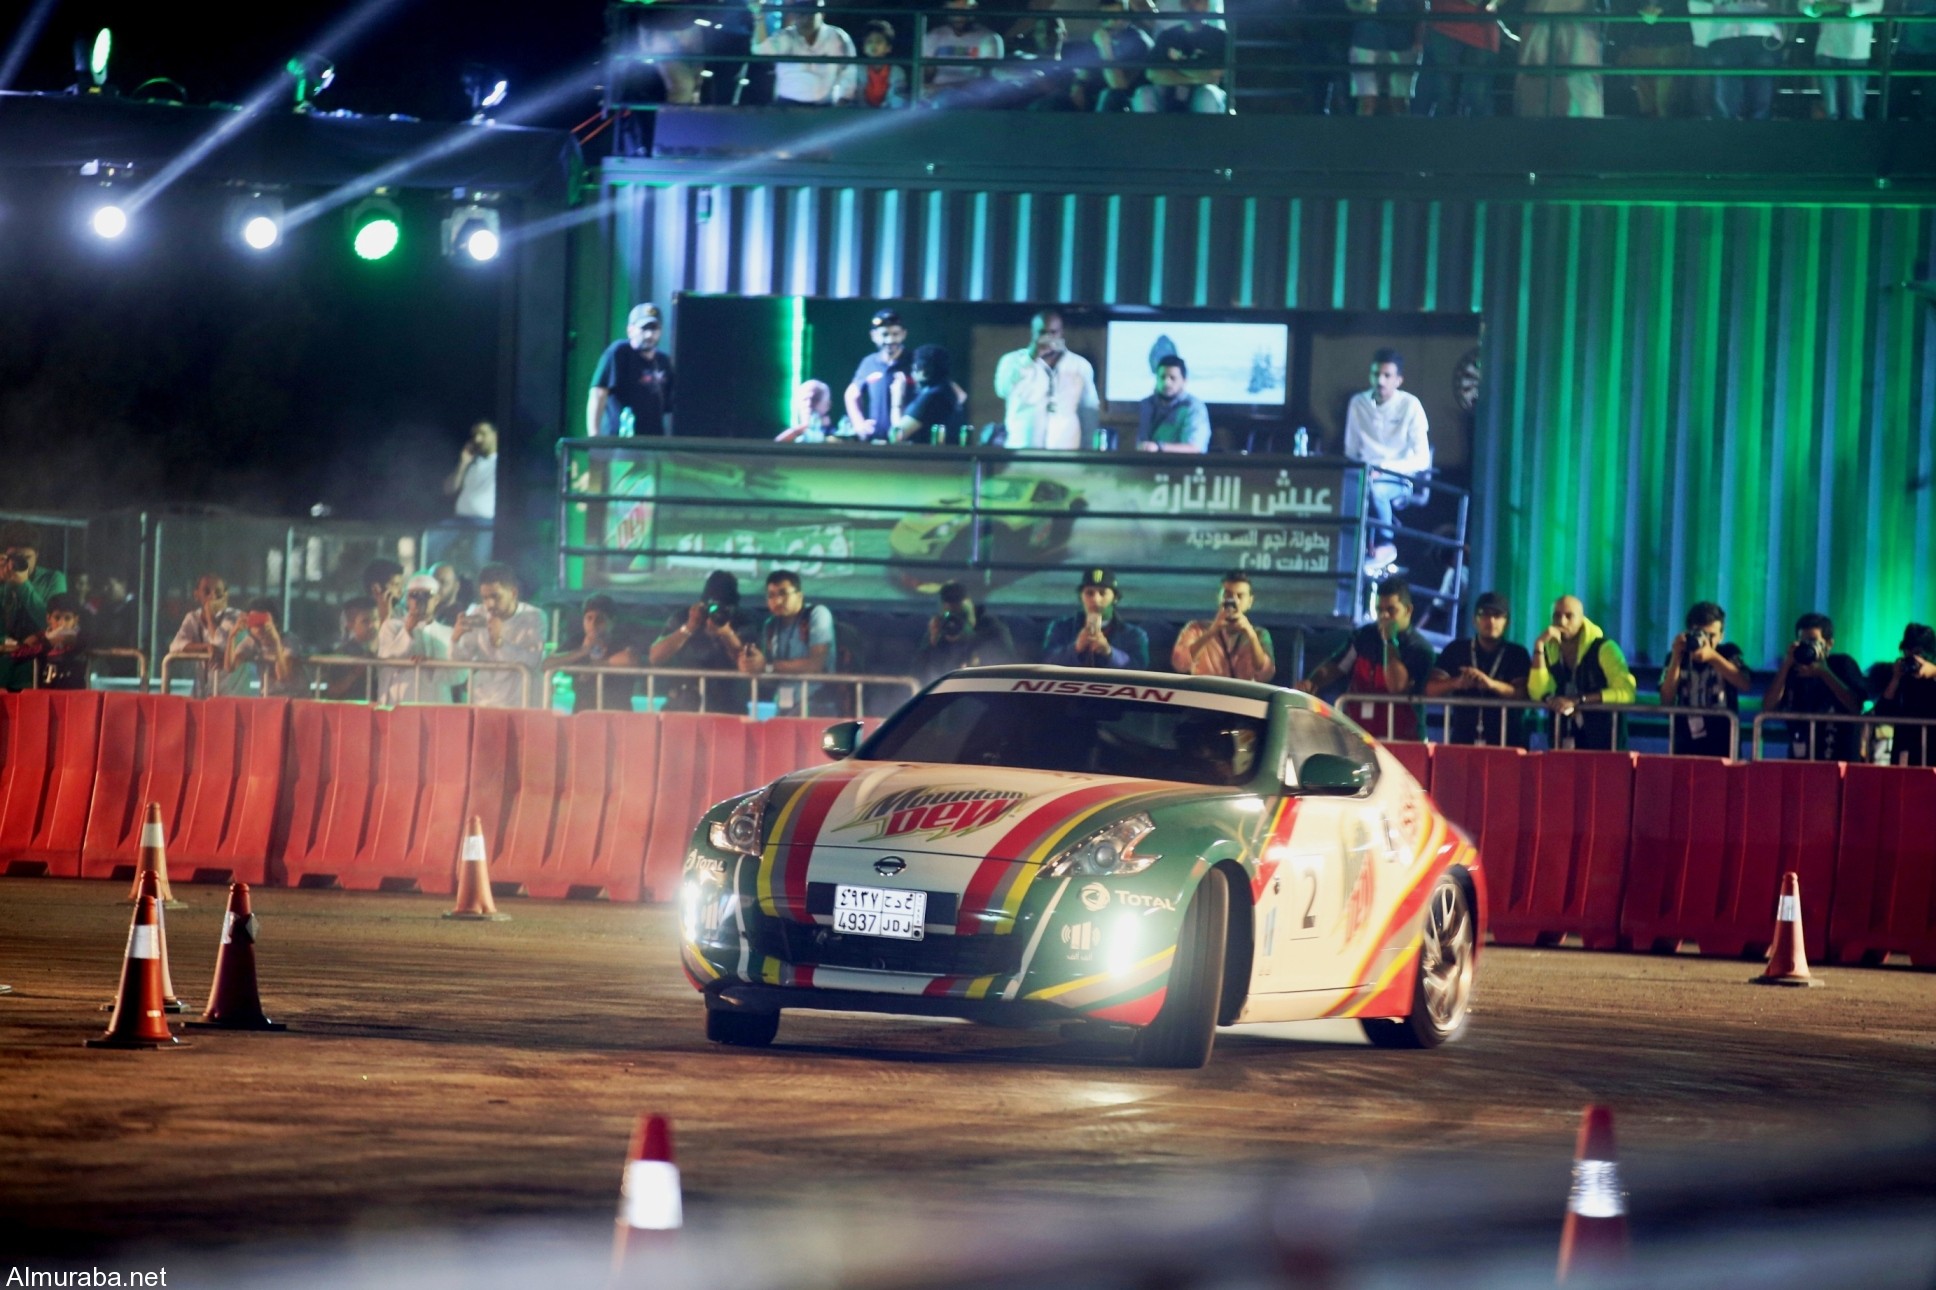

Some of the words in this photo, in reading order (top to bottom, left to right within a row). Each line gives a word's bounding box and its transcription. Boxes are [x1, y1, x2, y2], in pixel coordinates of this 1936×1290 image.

[1252, 470, 1333, 516] عيش
[1011, 680, 1174, 703] NISSAN
[863, 784, 1024, 821] Mountain
[1114, 889, 1177, 913] TOTAL
[1302, 867, 1317, 930] 2
[838, 911, 877, 932] 4937
